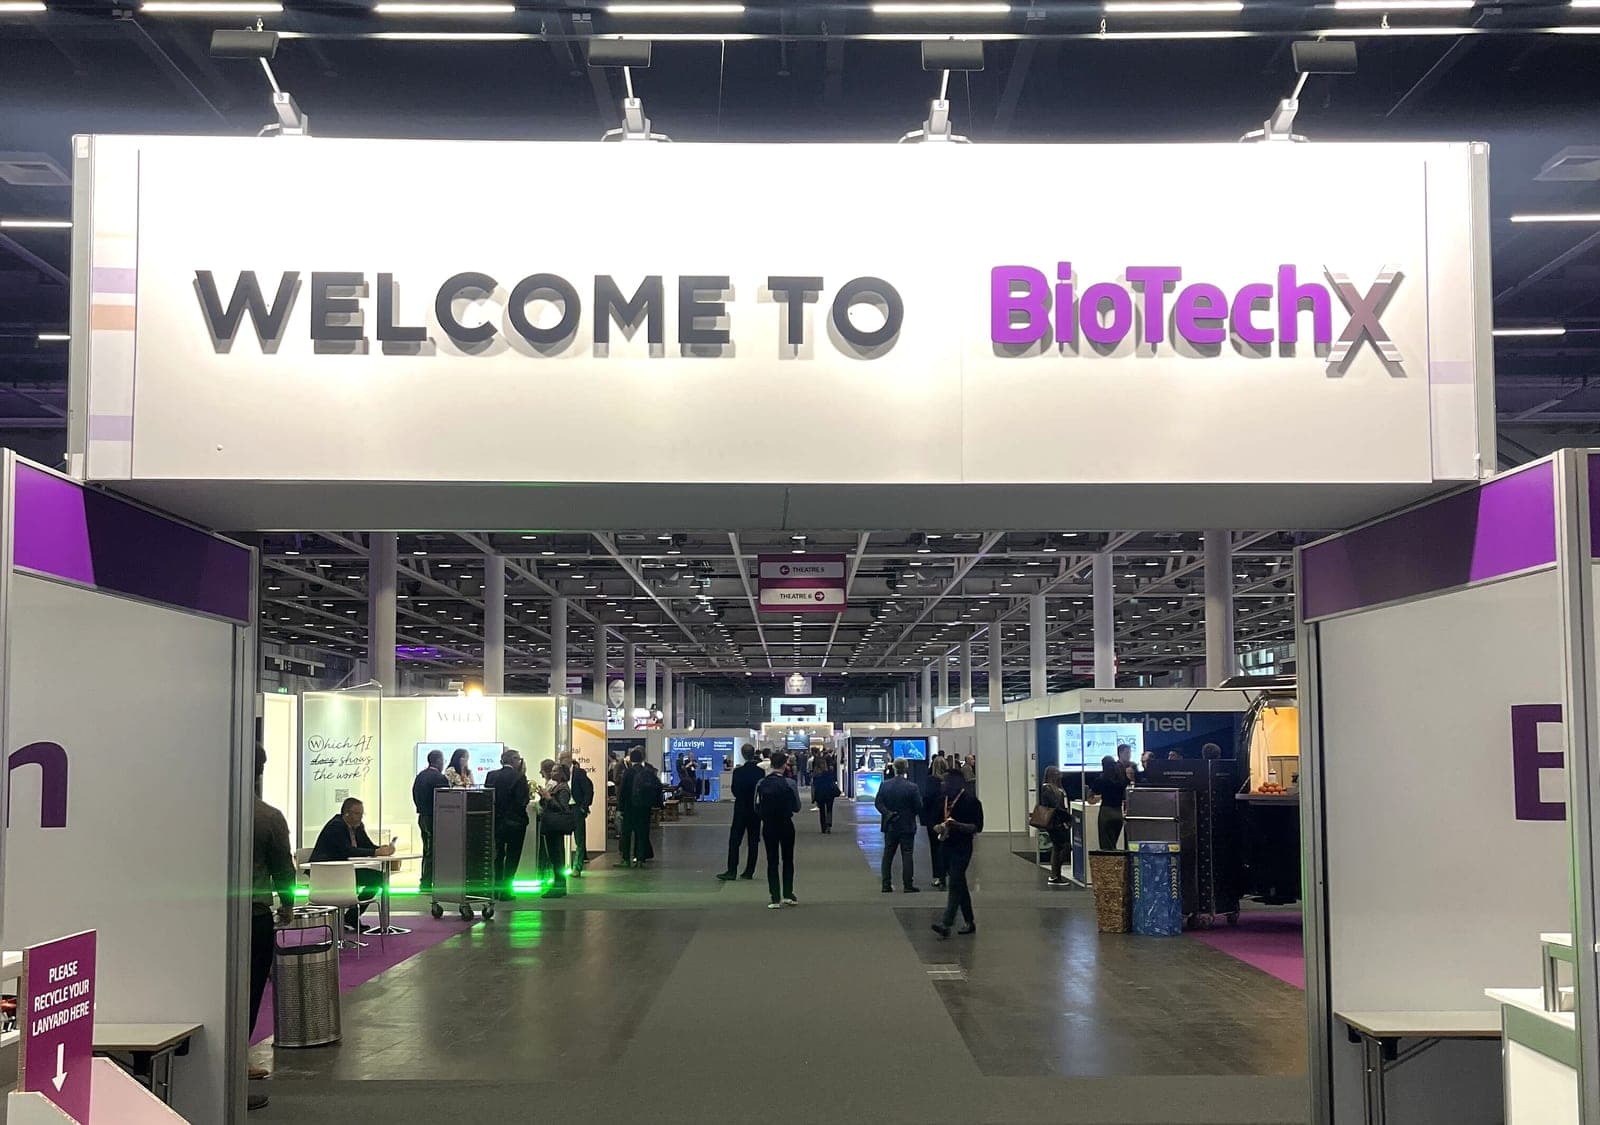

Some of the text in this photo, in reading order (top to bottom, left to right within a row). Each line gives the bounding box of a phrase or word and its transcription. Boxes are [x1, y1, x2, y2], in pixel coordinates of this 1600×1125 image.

[195, 270, 905, 347] WELCOME TO
[308, 734, 374, 753] Which AI
[313, 766, 370, 781] the work?
[338, 752, 374, 767] shows
[1511, 703, 1567, 821] E
[49, 960, 79, 984] PLEASE
[34, 979, 90, 1012] RECYCLE YOUR
[32, 1000, 90, 1037] LANYARD HERE
